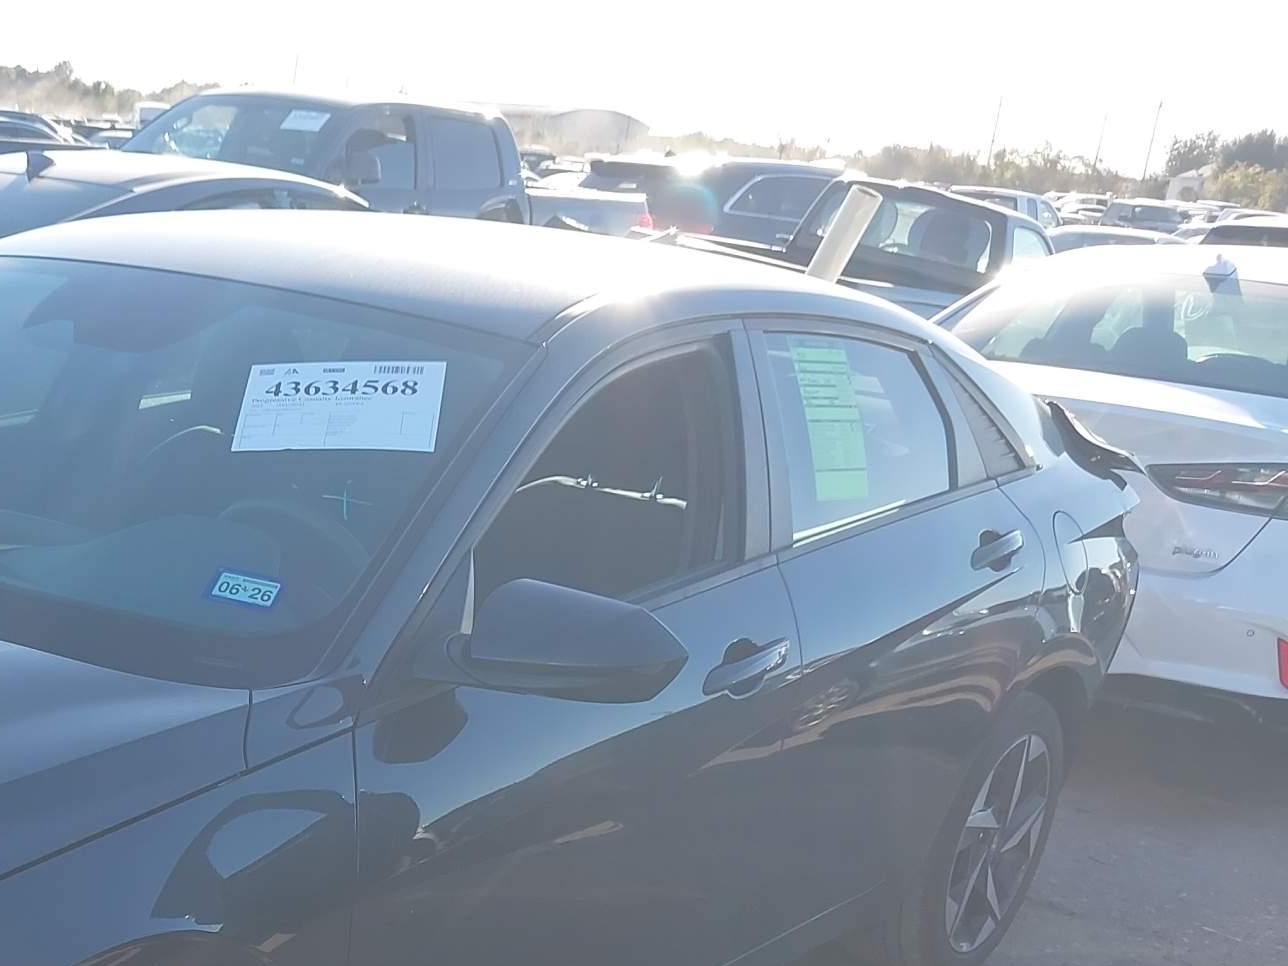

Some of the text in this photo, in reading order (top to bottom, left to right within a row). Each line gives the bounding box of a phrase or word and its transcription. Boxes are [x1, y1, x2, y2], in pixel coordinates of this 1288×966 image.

[265, 379, 419, 397] 43634568
[218, 581, 241, 595] 06
[247, 587, 273, 602] 26
